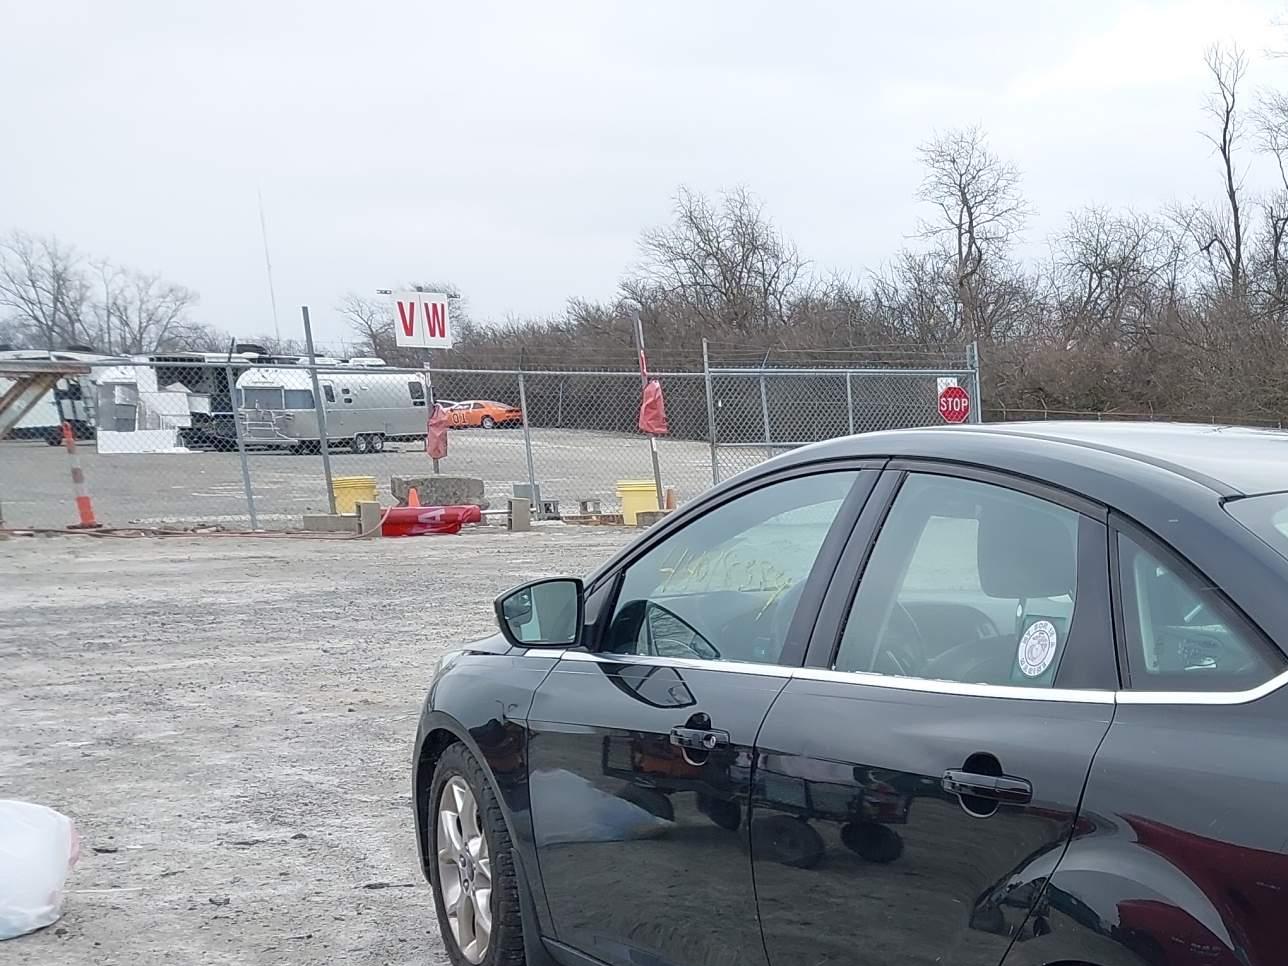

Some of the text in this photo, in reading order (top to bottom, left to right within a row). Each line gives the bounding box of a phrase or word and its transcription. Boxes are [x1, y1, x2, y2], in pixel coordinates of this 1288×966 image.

[397, 301, 446, 338] V W
[940, 398, 968, 411] STOP
[452, 413, 467, 424] 01
